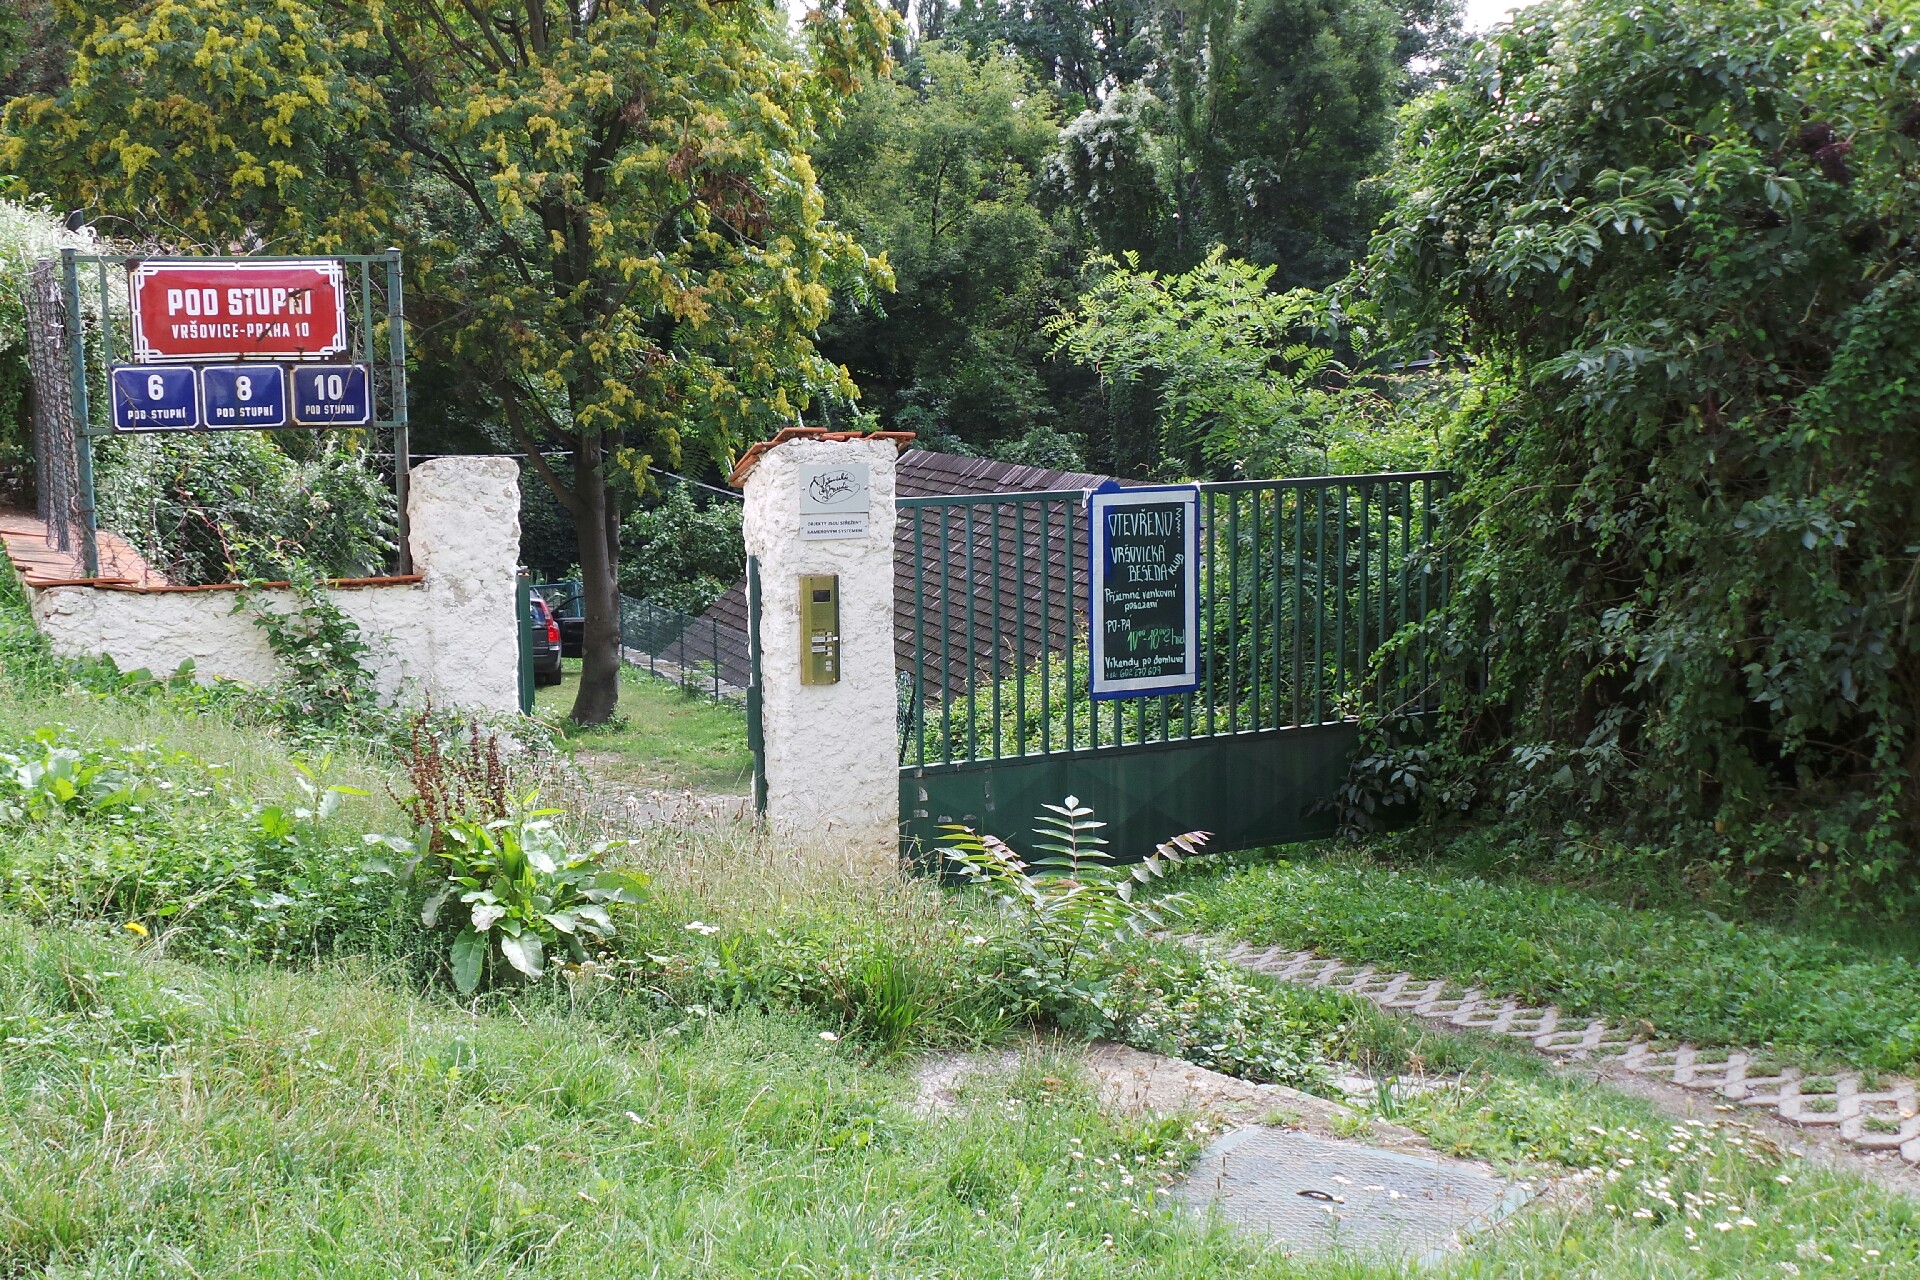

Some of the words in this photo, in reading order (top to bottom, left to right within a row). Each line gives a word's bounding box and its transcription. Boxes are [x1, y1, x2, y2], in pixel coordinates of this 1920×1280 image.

[167, 288, 219, 316] POD
[172, 320, 290, 339] VRŠOVICE-PRAHA
[294, 322, 310, 337] 10
[147, 374, 164, 401] 6
[235, 375, 252, 401] 8
[314, 374, 343, 401] 10
[127, 409, 146, 420] POD
[150, 406, 186, 419] STUPNÍ
[216, 407, 235, 418] POD
[239, 404, 274, 417] STUPNÍ
[305, 404, 321, 415] POD
[1110, 540, 1166, 564] VRŠOVICKÁ
[1127, 563, 1168, 582] BESEDA
[1167, 553, 1184, 576] KLUB
[1142, 657, 1152, 667] po
[1120, 668, 1133, 678] 602
[1134, 667, 1147, 677] 270
